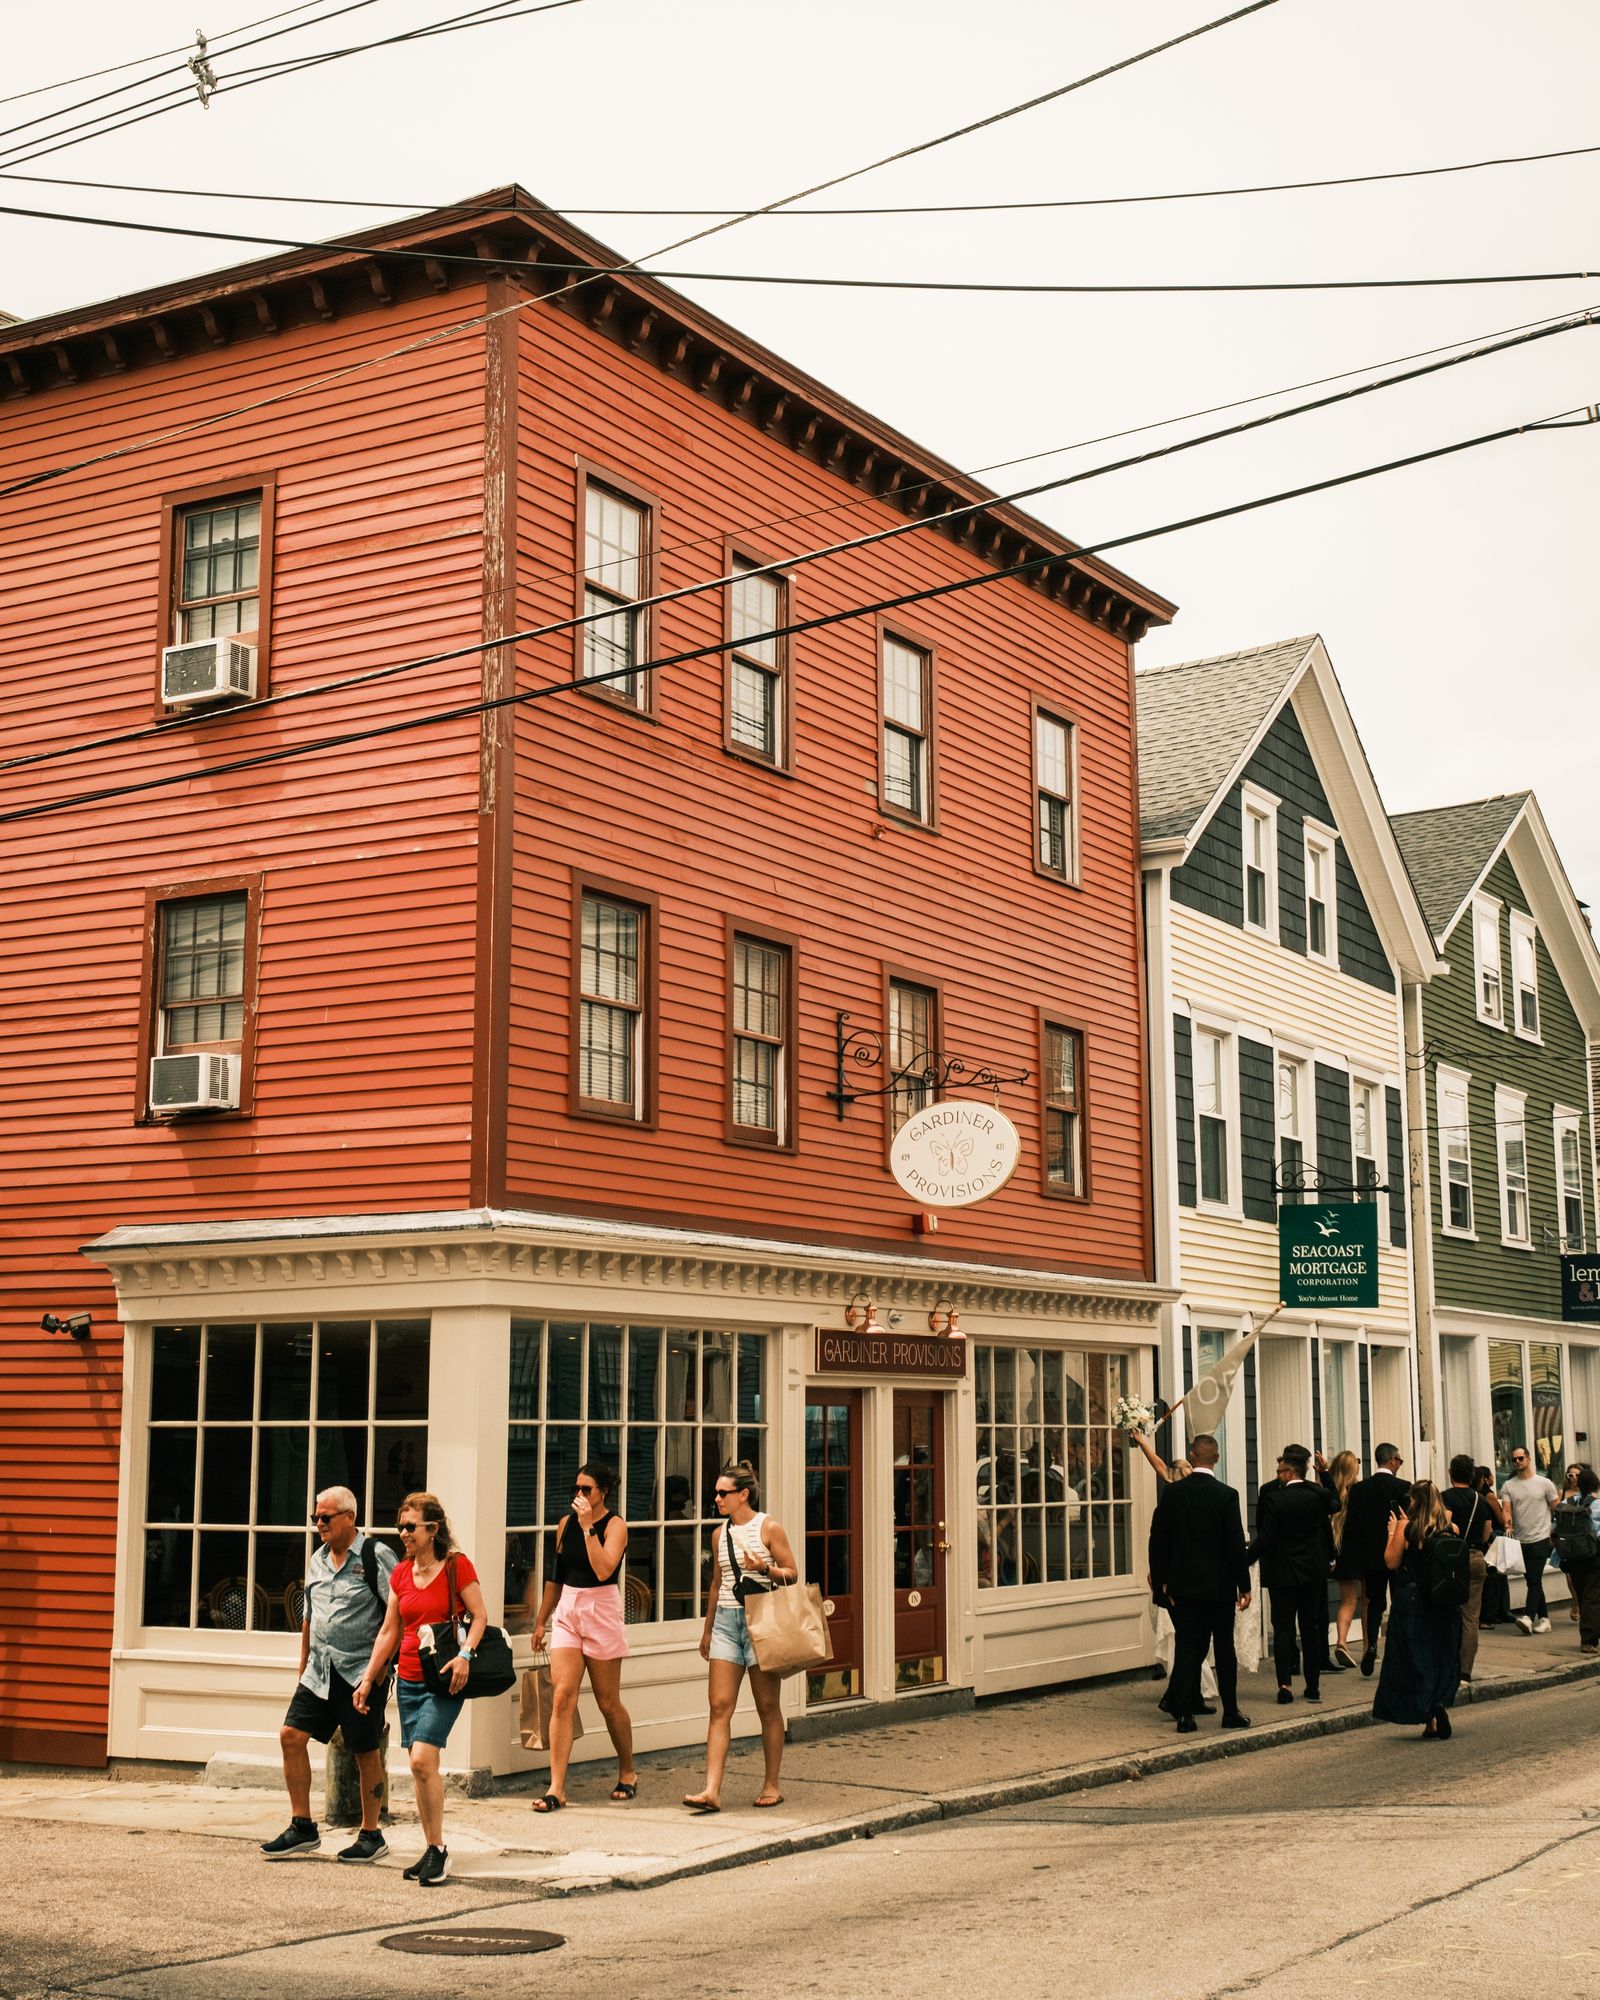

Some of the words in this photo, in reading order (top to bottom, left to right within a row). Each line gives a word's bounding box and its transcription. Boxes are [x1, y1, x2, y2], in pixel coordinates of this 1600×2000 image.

[909, 1110, 994, 1142] GARDINER
[906, 1159, 1003, 1198] PROVISIONS
[1292, 1245, 1364, 1258] SEACOAST
[1289, 1262, 1367, 1275] MORTGAGE
[1296, 1278, 1359, 1286] CORPORATION
[1298, 1294, 1316, 1302] You're
[1339, 1294, 1358, 1302] Home
[824, 1338, 888, 1363] GARDINER
[893, 1342, 962, 1367] PROVISIONS
[911, 1594, 919, 1604] IN
